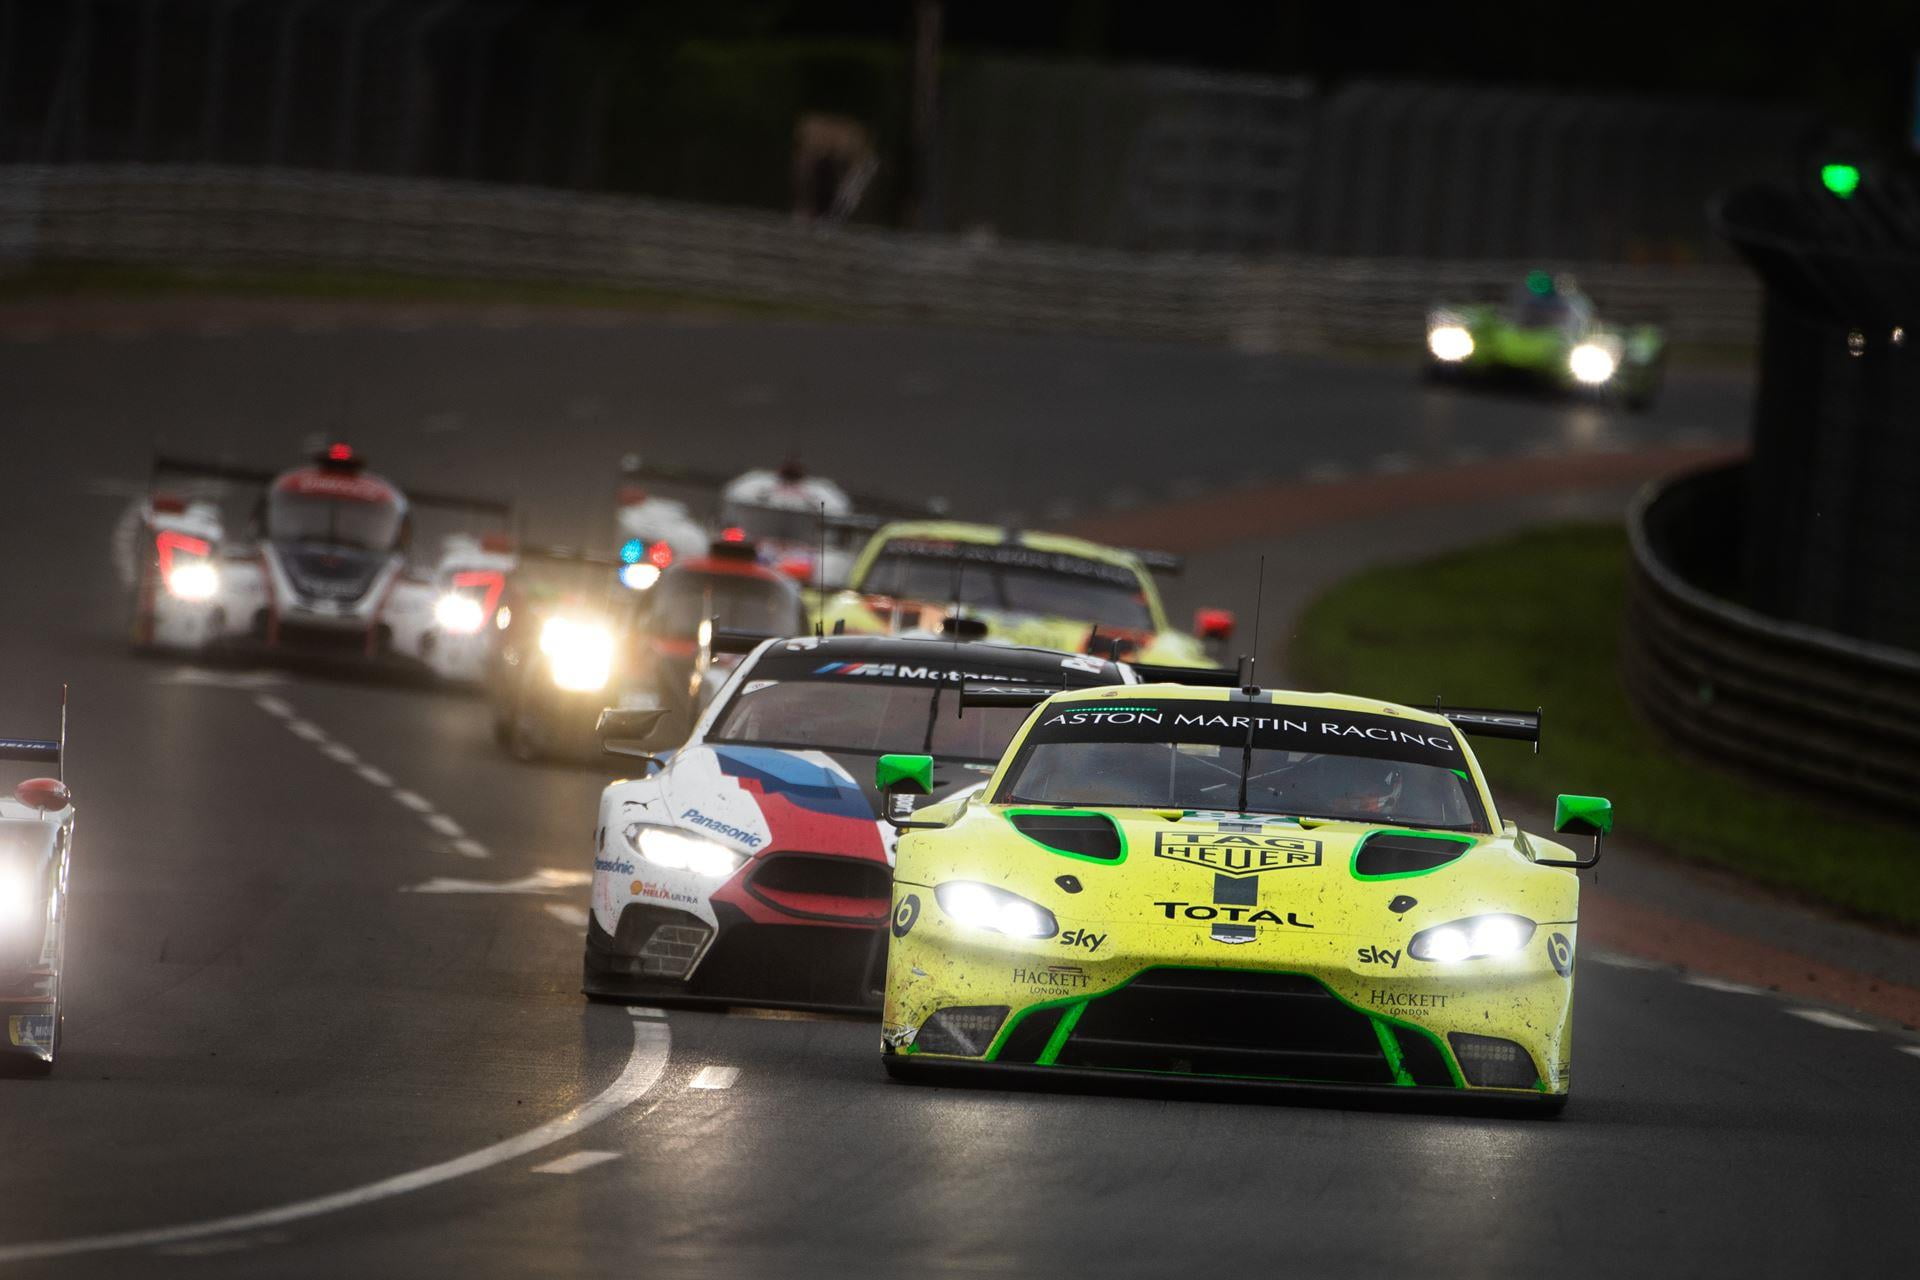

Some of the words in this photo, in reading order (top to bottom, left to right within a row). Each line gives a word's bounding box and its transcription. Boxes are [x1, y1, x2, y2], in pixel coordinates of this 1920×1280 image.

[1044, 713, 1163, 726] ASTON
[1174, 713, 1308, 732] MARTIN
[1321, 722, 1454, 751] RACING
[680, 808, 763, 848] Panasonic
[1171, 833, 1305, 851] TAG
[1167, 846, 1310, 870] HEUER
[642, 888, 671, 900] HELIX
[671, 893, 699, 904] ULTRA
[1153, 902, 1315, 929] TOTAL
[1060, 928, 1107, 953] sky
[1357, 945, 1402, 969] sky
[1012, 967, 1091, 988] HACKETT
[1029, 986, 1070, 996] LONDON
[1370, 989, 1449, 1008] HACKETT
[1389, 1007, 1430, 1017] LONDON
